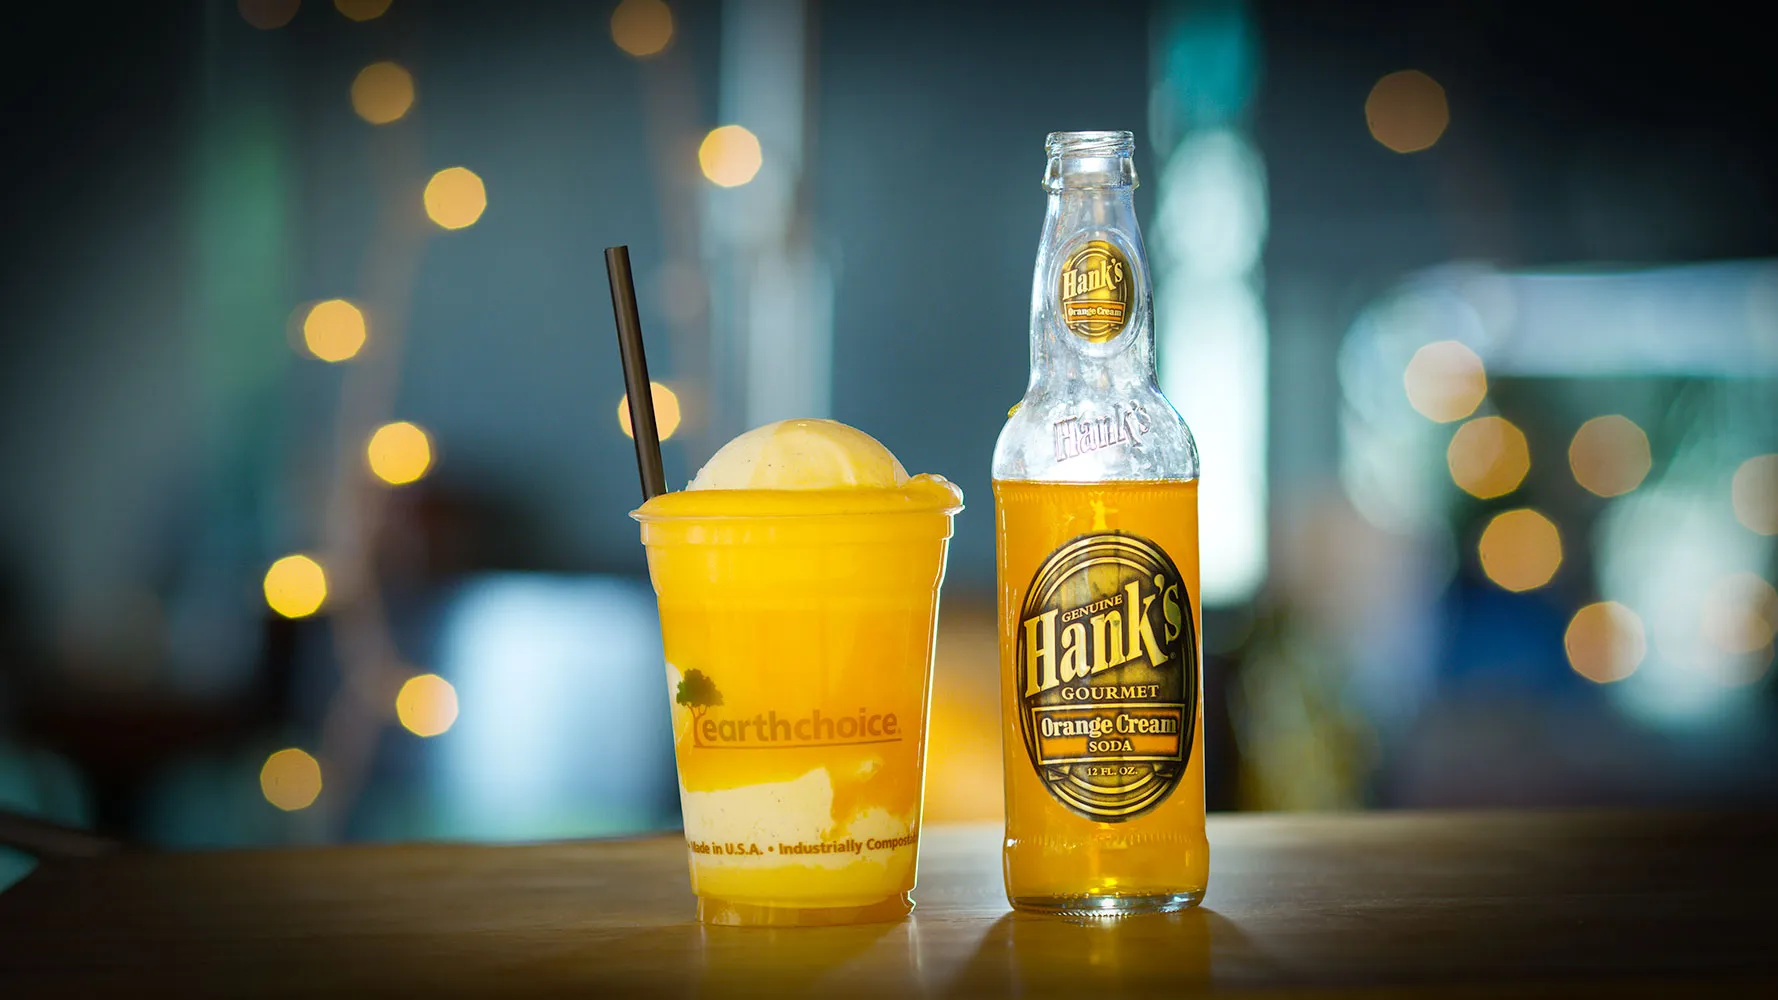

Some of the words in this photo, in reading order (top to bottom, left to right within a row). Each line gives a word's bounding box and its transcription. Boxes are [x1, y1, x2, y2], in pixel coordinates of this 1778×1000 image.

[1062, 258, 1123, 300] Hank's
[1068, 307, 1096, 317] Orange
[1097, 306, 1122, 316] Cream
[1053, 400, 1152, 462] Hank's
[1061, 594, 1123, 623] GENUINE
[1023, 573, 1182, 698] Hank's
[1061, 685, 1160, 700] GOURMET
[1041, 716, 1112, 738] Orange
[1116, 714, 1177, 734] Cream
[1089, 740, 1133, 752] SODA
[1087, 767, 1098, 776] 12
[1101, 767, 1117, 776] FL.
[1119, 766, 1138, 776] OZ.
[712, 842, 723, 855] in
[725, 842, 764, 855] U.S.A.
[779, 839, 863, 855] Industrially
